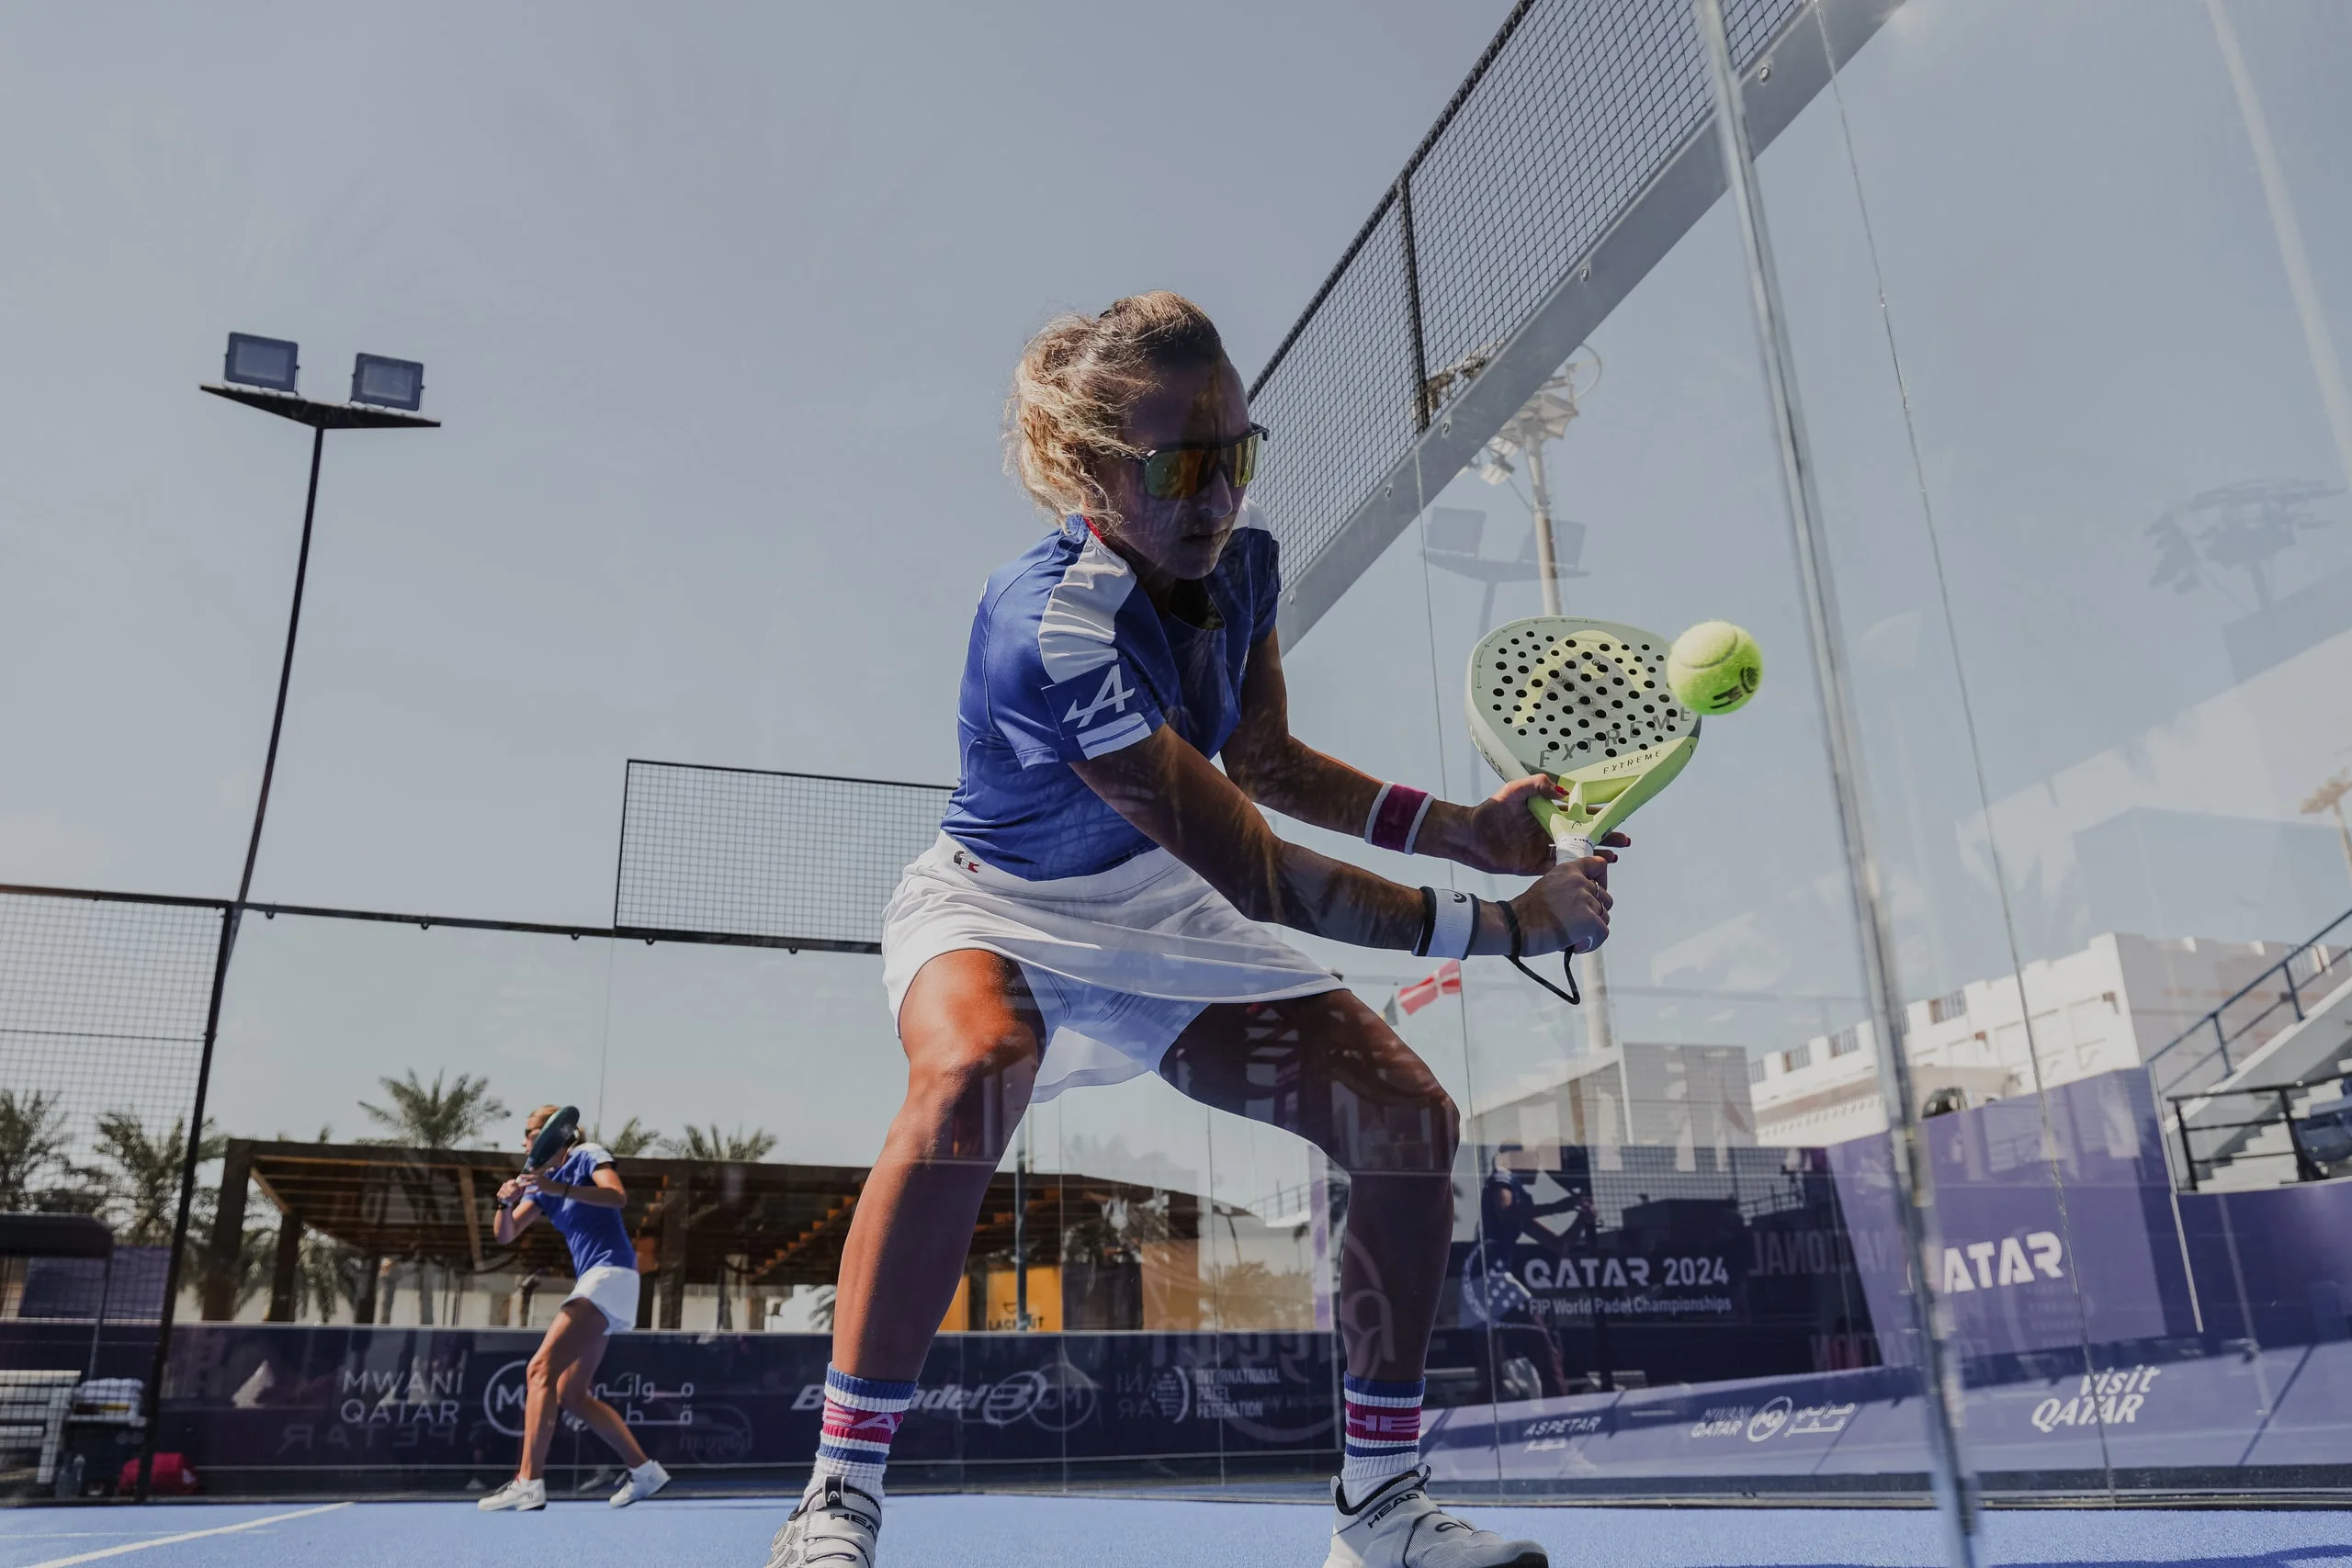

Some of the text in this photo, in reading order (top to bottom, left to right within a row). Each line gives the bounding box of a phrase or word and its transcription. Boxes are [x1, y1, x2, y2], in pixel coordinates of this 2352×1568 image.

[1538, 705, 1691, 769] EXTREME
[1602, 750, 1661, 774] EXTREME
[1524, 1256, 1730, 1290] QATAR 2024
[1940, 1230, 2065, 1295] ATAR
[1529, 1294, 1733, 1316] FIP World Padel Championships
[341, 1370, 465, 1396] MWANI
[1195, 1367, 1281, 1384] INTERNATIONAL
[2080, 1363, 2162, 1396] visit
[791, 1383, 988, 1410] Badel
[1196, 1384, 1231, 1402] PADEL
[339, 1398, 461, 1425] QATAR
[1196, 1401, 1263, 1419] FEDERATION
[2030, 1393, 2145, 1434] QATAR
[1522, 1416, 1602, 1438] ASPETAR
[1690, 1420, 1743, 1439] QATAR
[1367, 1492, 1419, 1529] HEAD
